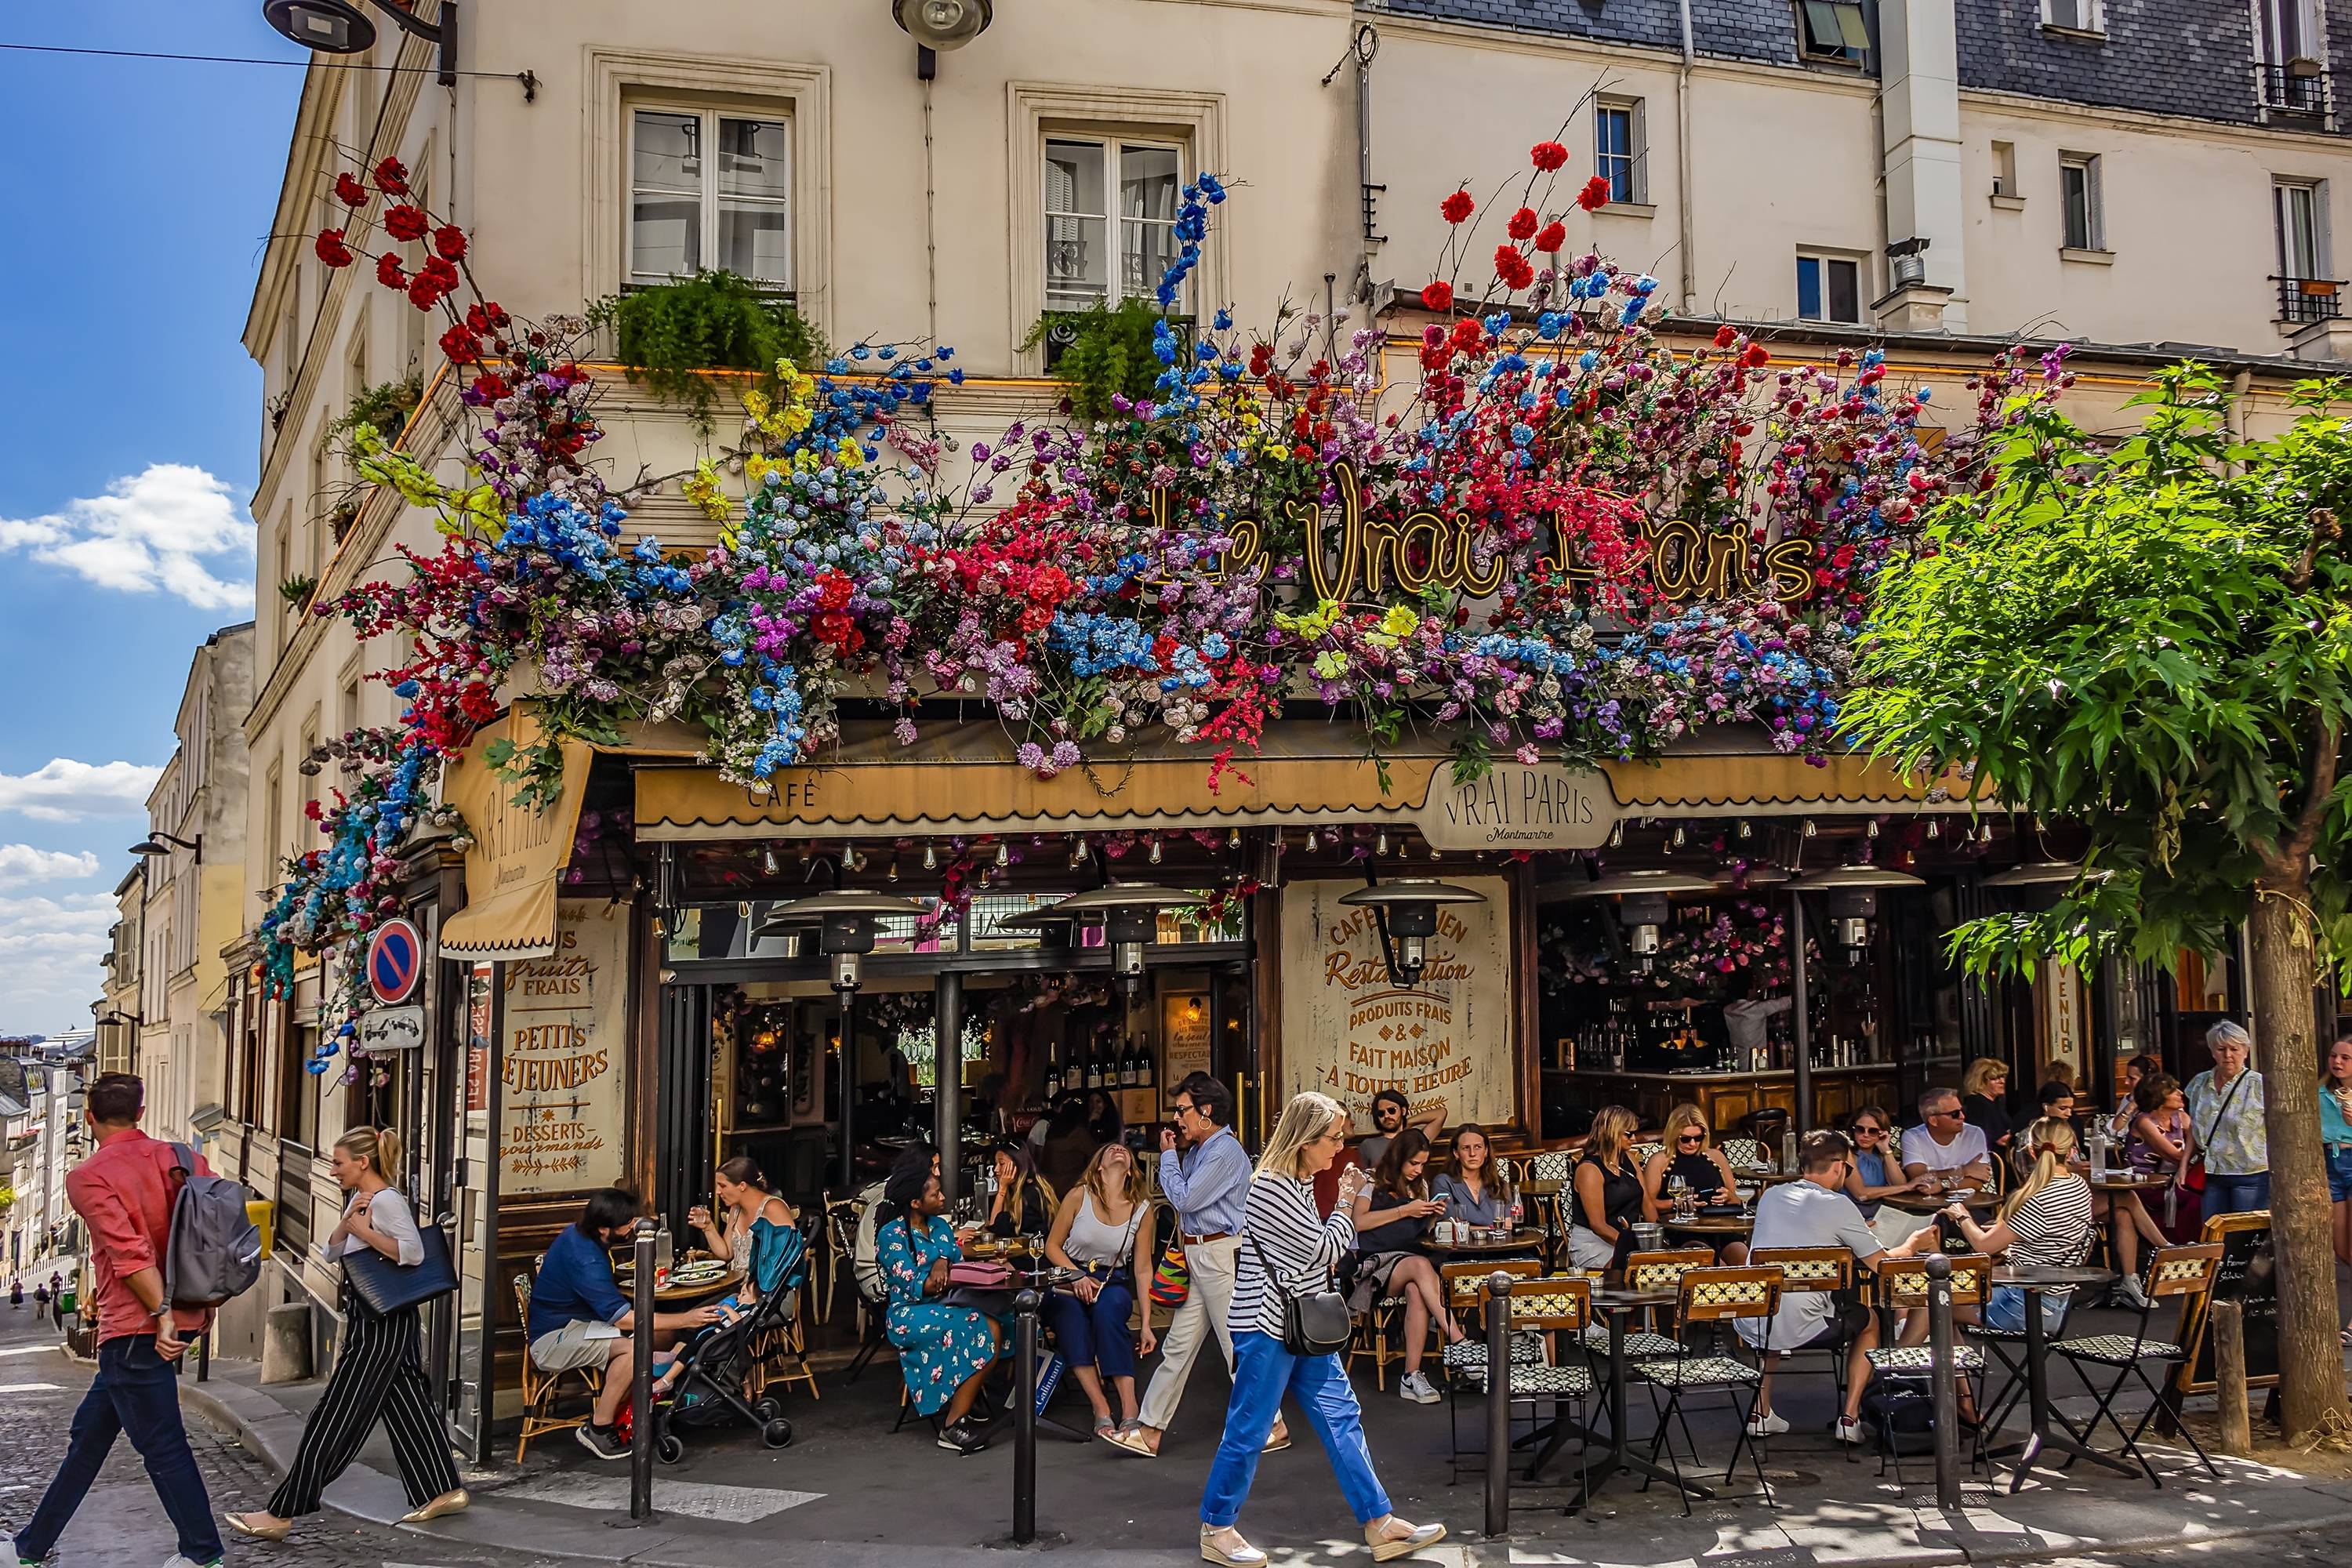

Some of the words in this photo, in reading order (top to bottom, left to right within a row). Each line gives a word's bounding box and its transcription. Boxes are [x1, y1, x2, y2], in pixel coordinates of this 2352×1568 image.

[1133, 483, 1270, 590] Le
[1282, 458, 1507, 602] Vrai
[1445, 771, 1511, 826] VRAI
[1523, 771, 1594, 825] PARIS
[1486, 826, 1555, 843] Montmartre
[505, 954, 600, 993] fruits
[522, 978, 581, 996] FRAIS
[1349, 1000, 1413, 1031] PRODUITS
[1416, 1002, 1452, 1025] FRAIS
[514, 1024, 586, 1051] PETITS
[1395, 1022, 1407, 1042] &
[1349, 1040, 1387, 1069] FAIT
[1390, 1036, 1450, 1069] MAISON
[502, 1048, 608, 1095] ÉJEUNERS
[1345, 1071, 1409, 1096] TOUTE
[1413, 1056, 1473, 1094] HEURE
[499, 1135, 604, 1161] gourmands
[513, 1122, 586, 1143] DESSERTS
[1036, 1359, 1063, 1406] Gallimard
